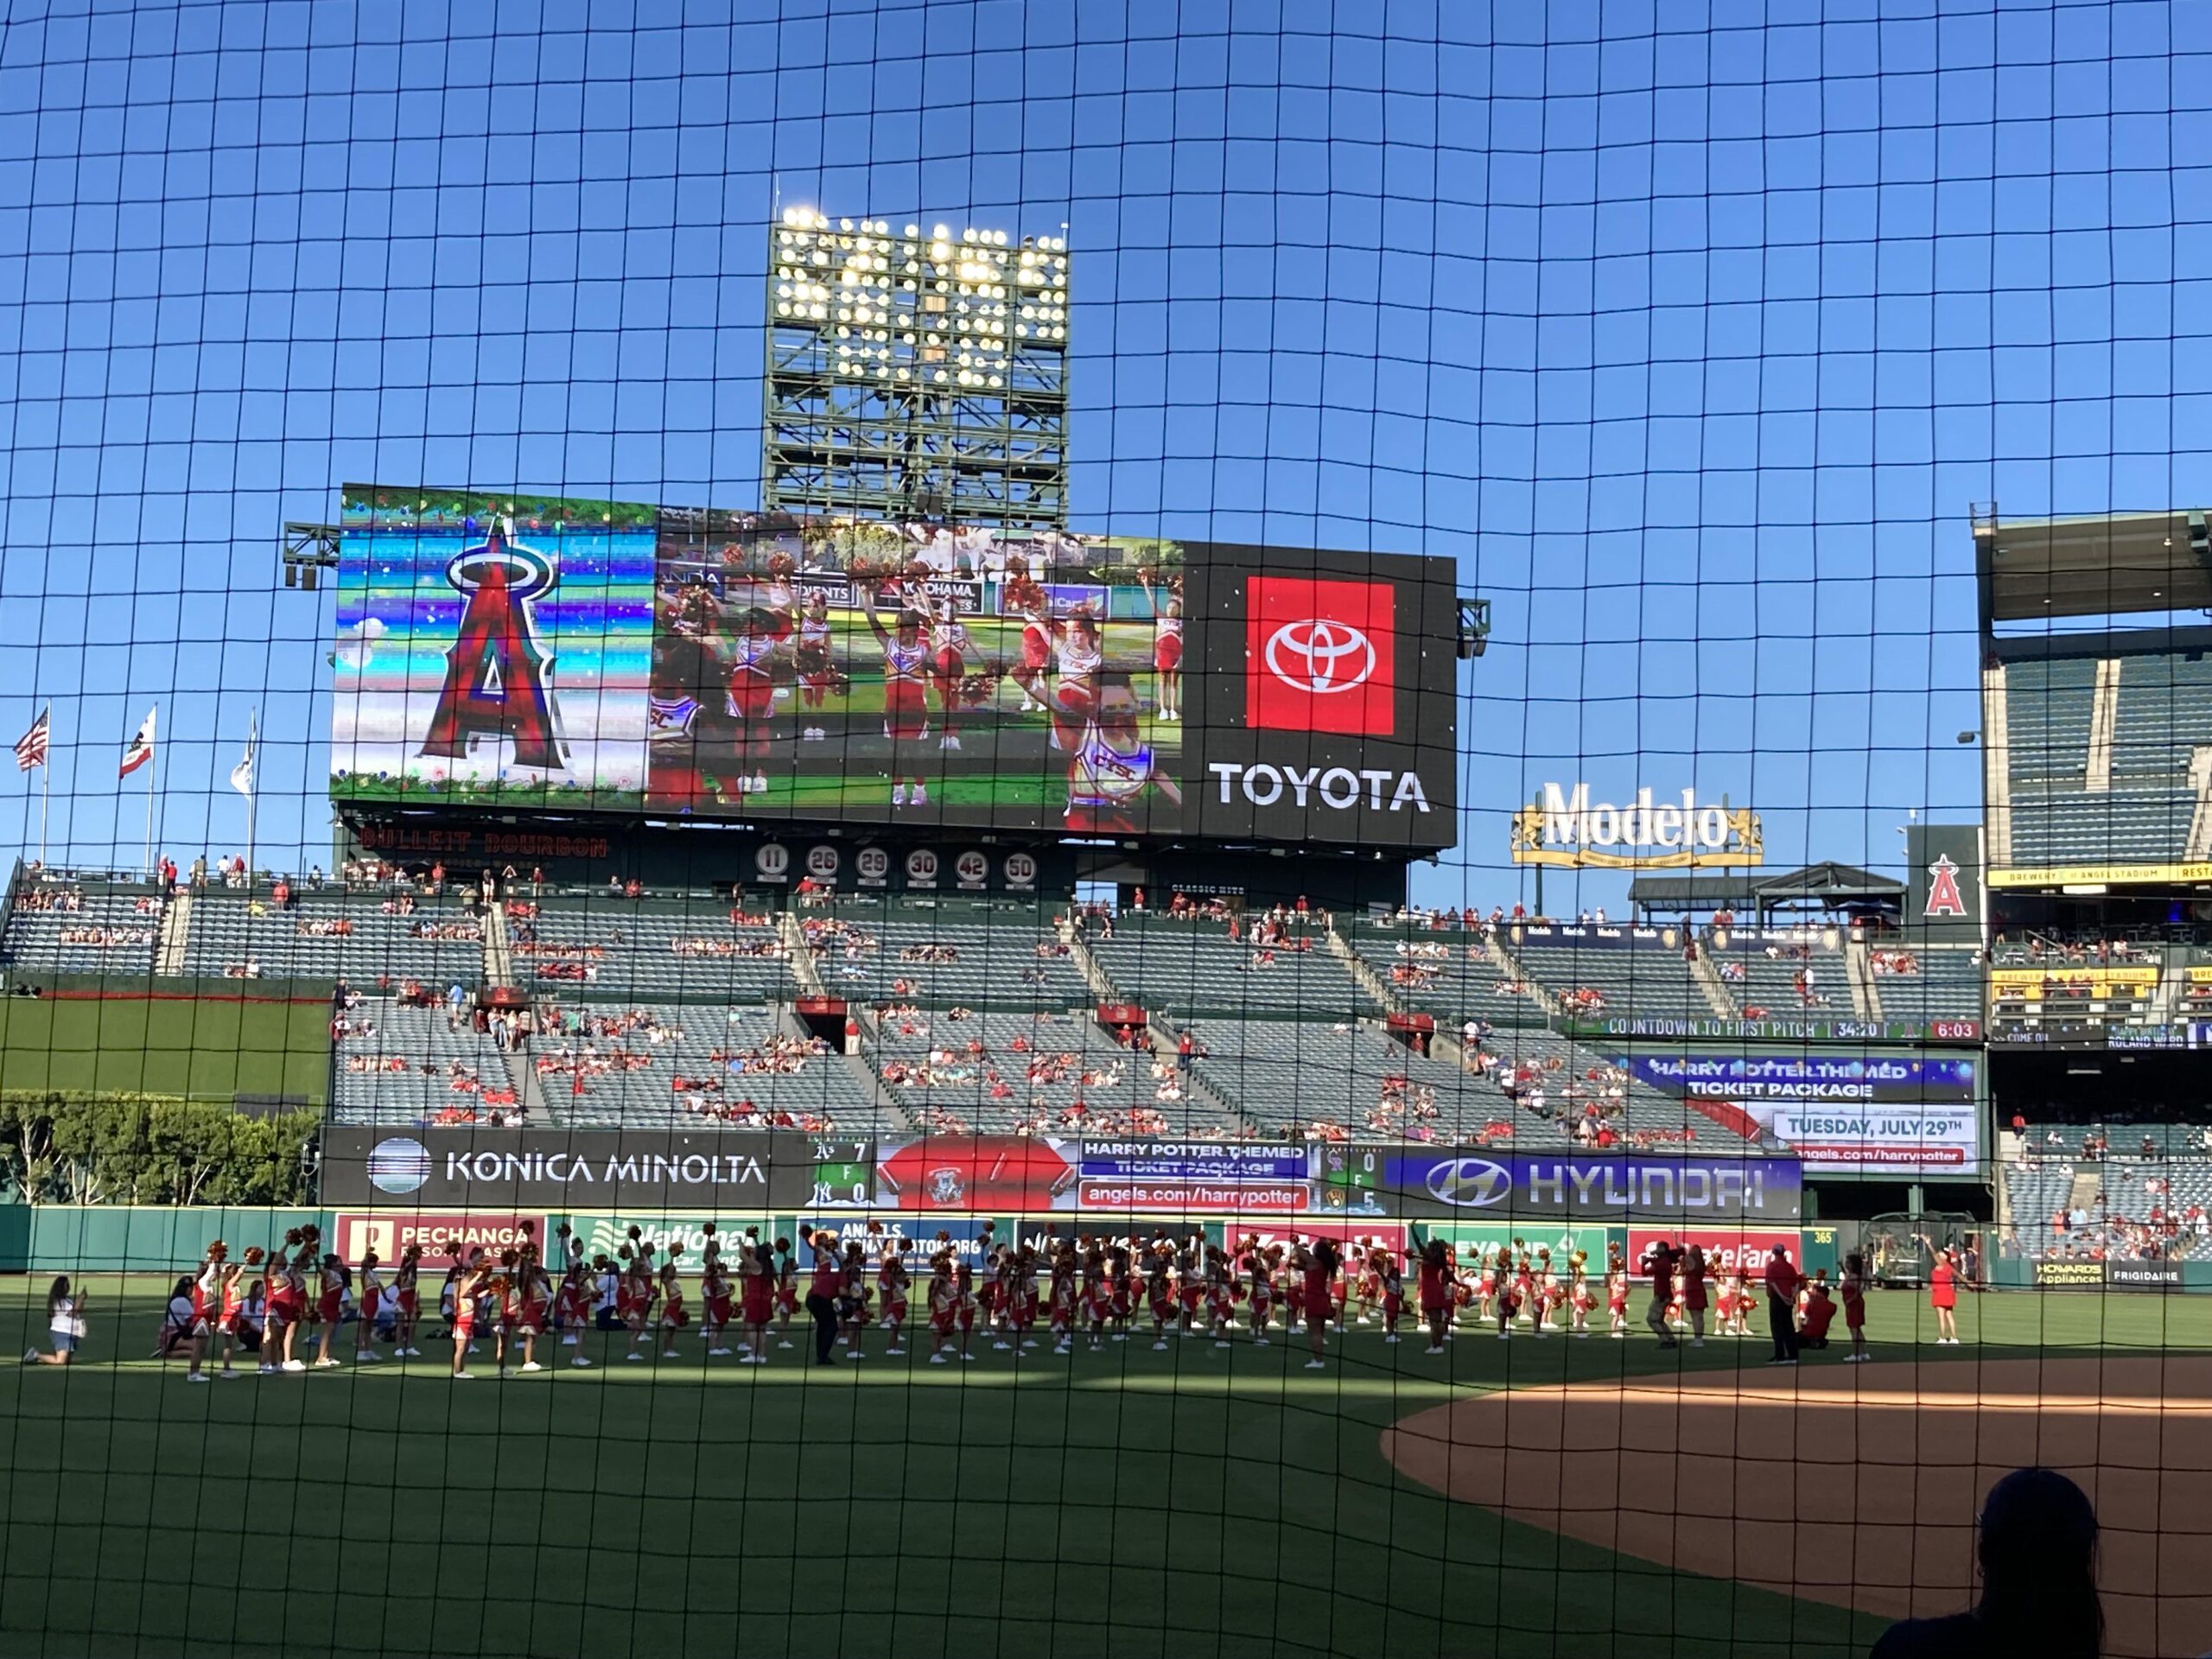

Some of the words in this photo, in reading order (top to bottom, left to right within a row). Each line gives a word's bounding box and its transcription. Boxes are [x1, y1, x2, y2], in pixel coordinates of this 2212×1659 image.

[1209, 763, 1430, 813] TOYOTA
[1543, 782, 1729, 848] Modelo
[359, 827, 471, 852] BULLEIT
[484, 832, 608, 858] BOURBON
[765, 850, 779, 868] 11
[811, 851, 836, 869] 26
[861, 855, 886, 871] 29
[911, 855, 934, 873] 30
[959, 857, 983, 875] 42
[1009, 860, 1032, 877] 50
[2010, 872, 2056, 882] BREWERY
[2081, 870, 2110, 880] ANGEL
[2113, 869, 2158, 879] STADIUM
[1608, 1019, 1698, 1035] COUNTDOWN
[1703, 1020, 1721, 1036] TO
[1726, 1020, 1765, 1037] FIRST
[1772, 1021, 1815, 1037] PITCH
[1938, 1023, 1973, 1037] 6:03
[1688, 1082, 1764, 1096] TICKET
[1768, 1083, 1873, 1097] PACKAGE
[1789, 1118, 1872, 1137] TUESDAY,
[1878, 1120, 1921, 1135] JULY
[854, 1143, 865, 1161] 7
[1084, 1142, 1147, 1156] HARRY
[1152, 1143, 1222, 1158] POTTER
[1226, 1145, 1304, 1159] THEMED
[446, 1152, 594, 1182] KONICA
[604, 1154, 766, 1184] MINOLTA
[1116, 1160, 1182, 1173] TICKET
[1187, 1161, 1274, 1175] PACKAGE
[853, 1183, 864, 1203] 0
[1529, 1164, 1763, 1208] HYUNDAI
[1089, 1186, 1300, 1211] angels.com/harrypotter
[401, 1227, 528, 1244] PECHANGA
[1814, 1231, 1832, 1244] 365
[2037, 1263, 2102, 1274] HOWARDS
[2113, 1271, 2178, 1281] FRIGIDAIRE
[2037, 1274, 2102, 1284] Appliances
